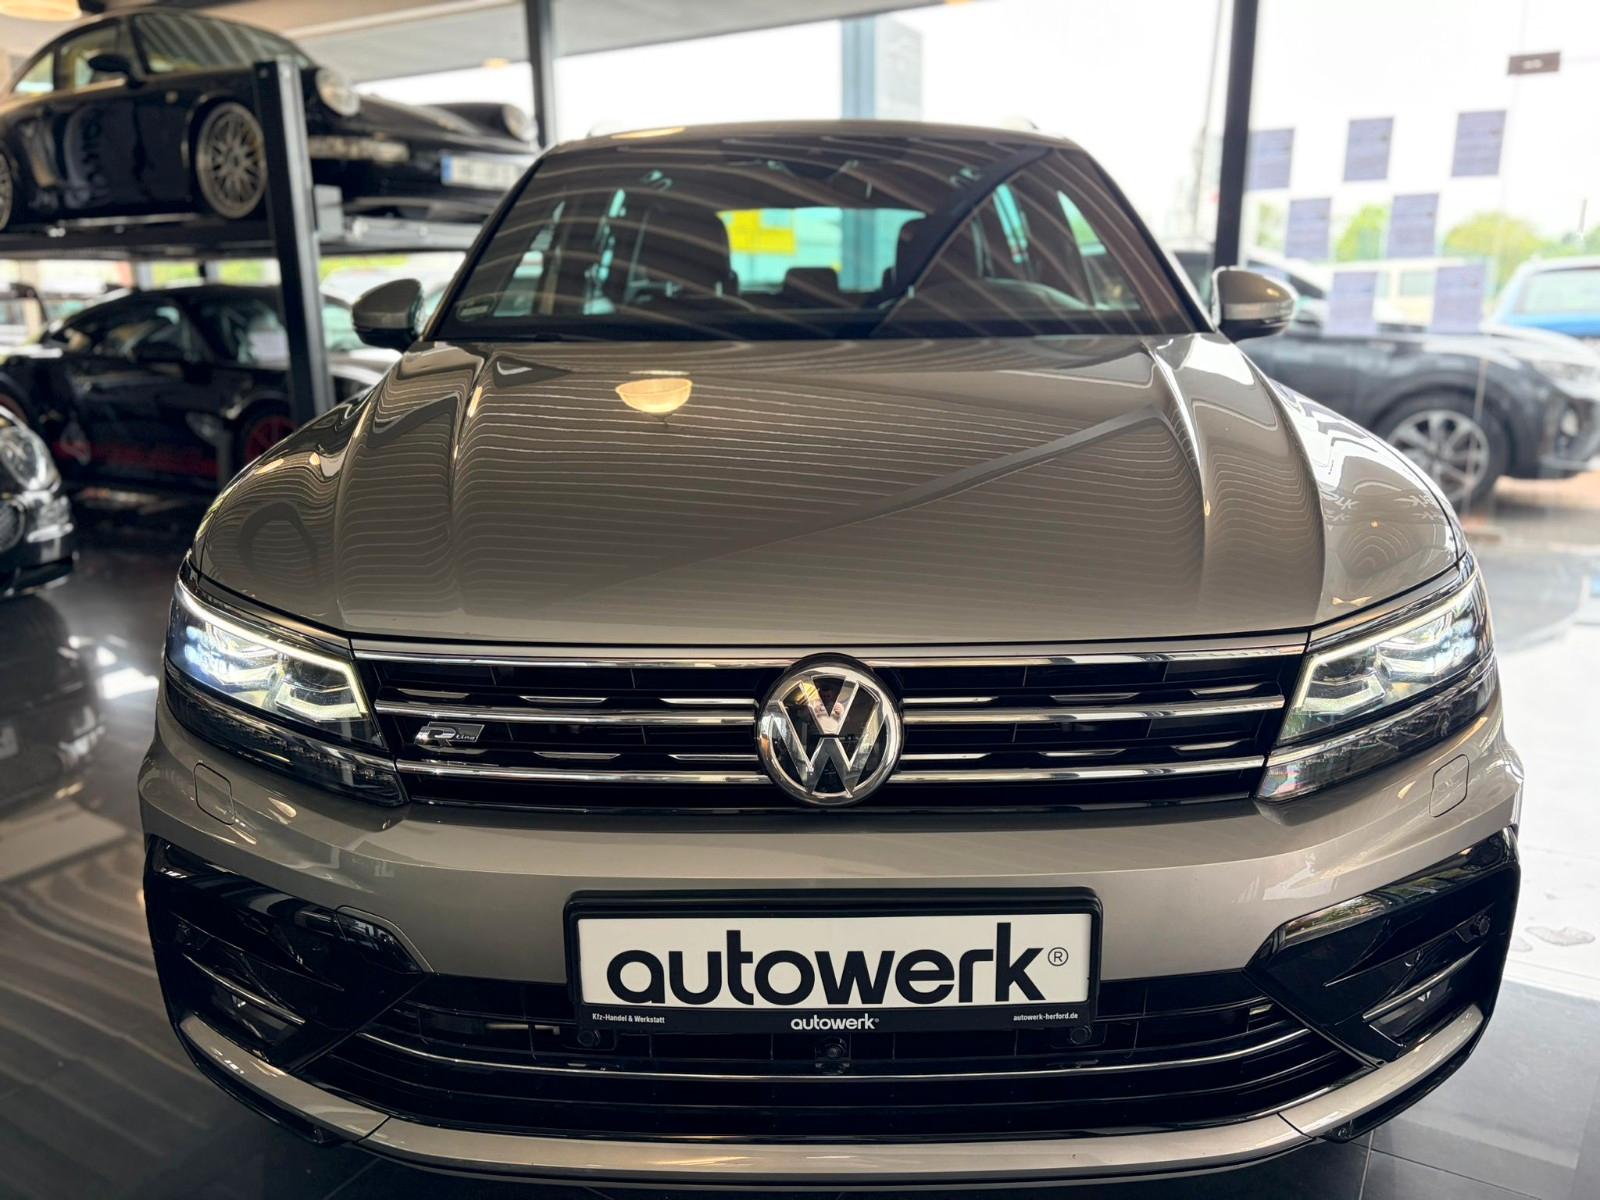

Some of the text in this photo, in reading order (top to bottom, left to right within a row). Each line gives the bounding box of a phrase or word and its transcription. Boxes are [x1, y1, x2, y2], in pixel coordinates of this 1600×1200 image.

[768, 672, 889, 798] VW
[592, 1013, 627, 1022] Kfz-Handel
[634, 1015, 665, 1023] Werkstatt
[1013, 1011, 1078, 1021] autowerk-herford.de
